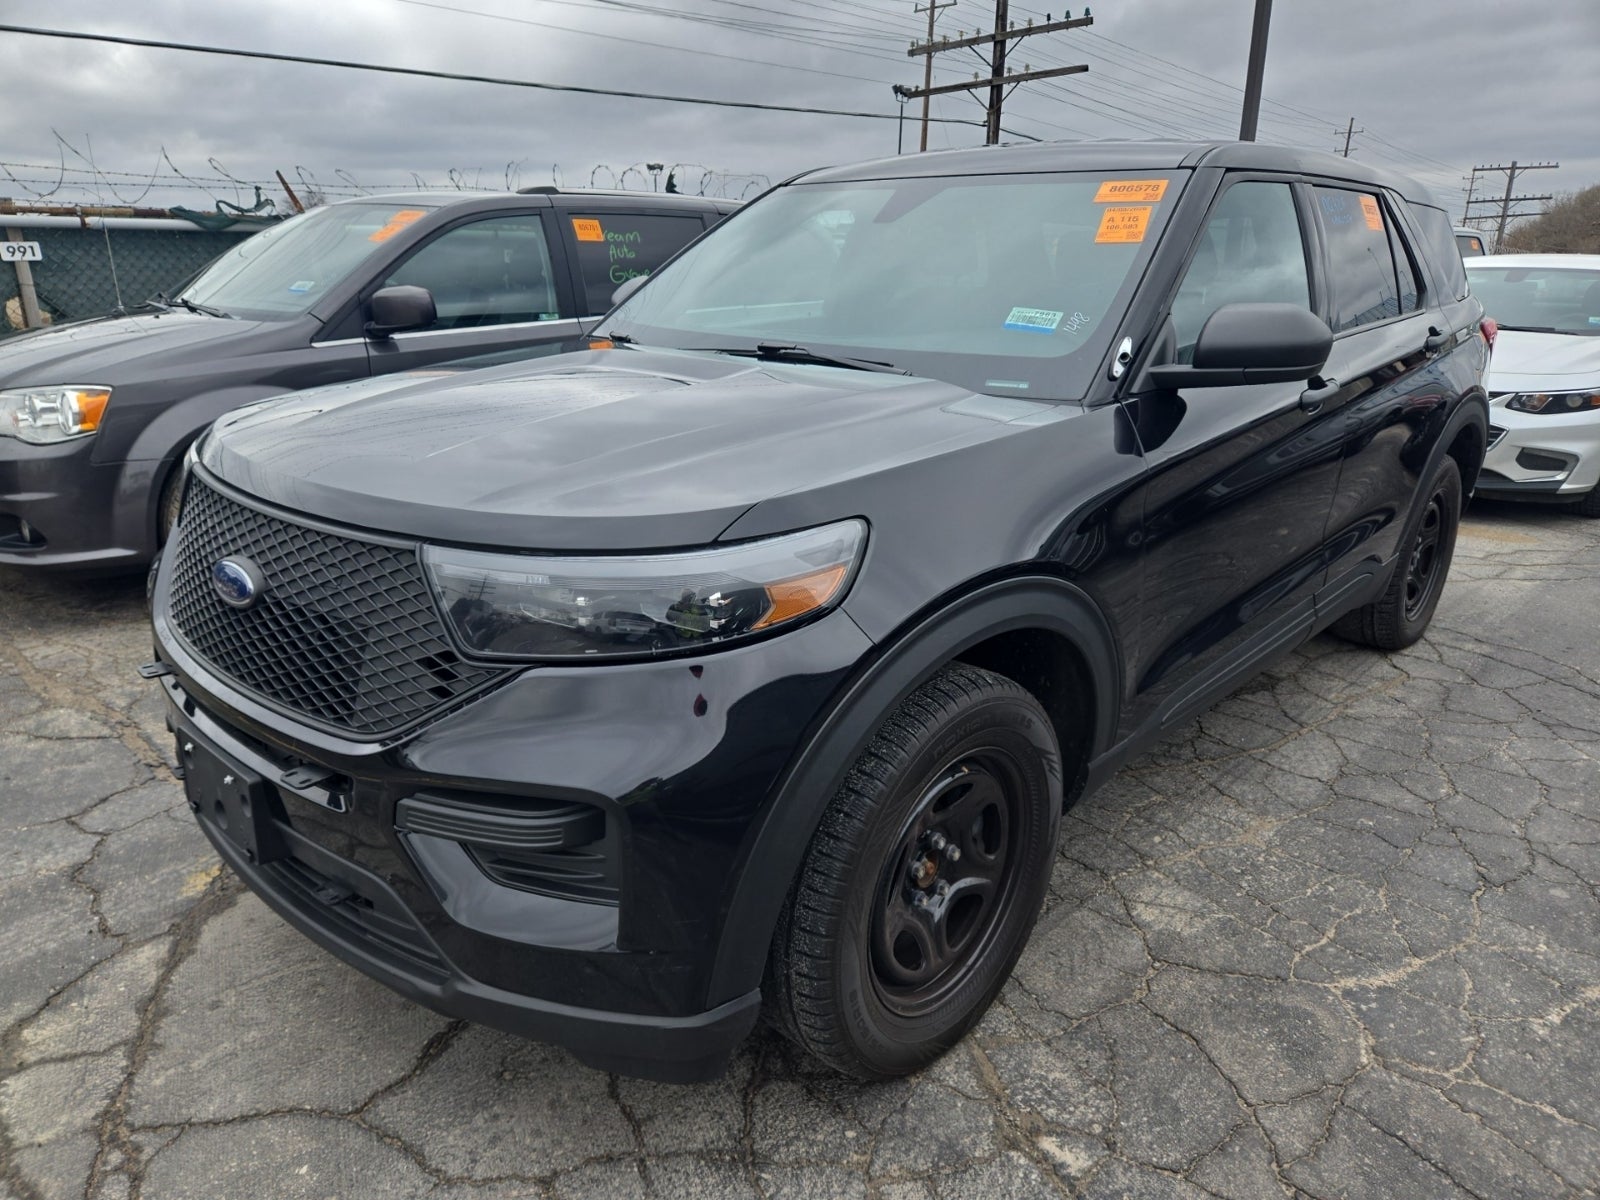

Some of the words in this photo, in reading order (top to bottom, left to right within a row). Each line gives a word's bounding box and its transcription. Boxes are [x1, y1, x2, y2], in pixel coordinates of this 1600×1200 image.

[1109, 184, 1160, 193] 806578
[6, 245, 36, 257] 991
[609, 244, 636, 262] Auto
